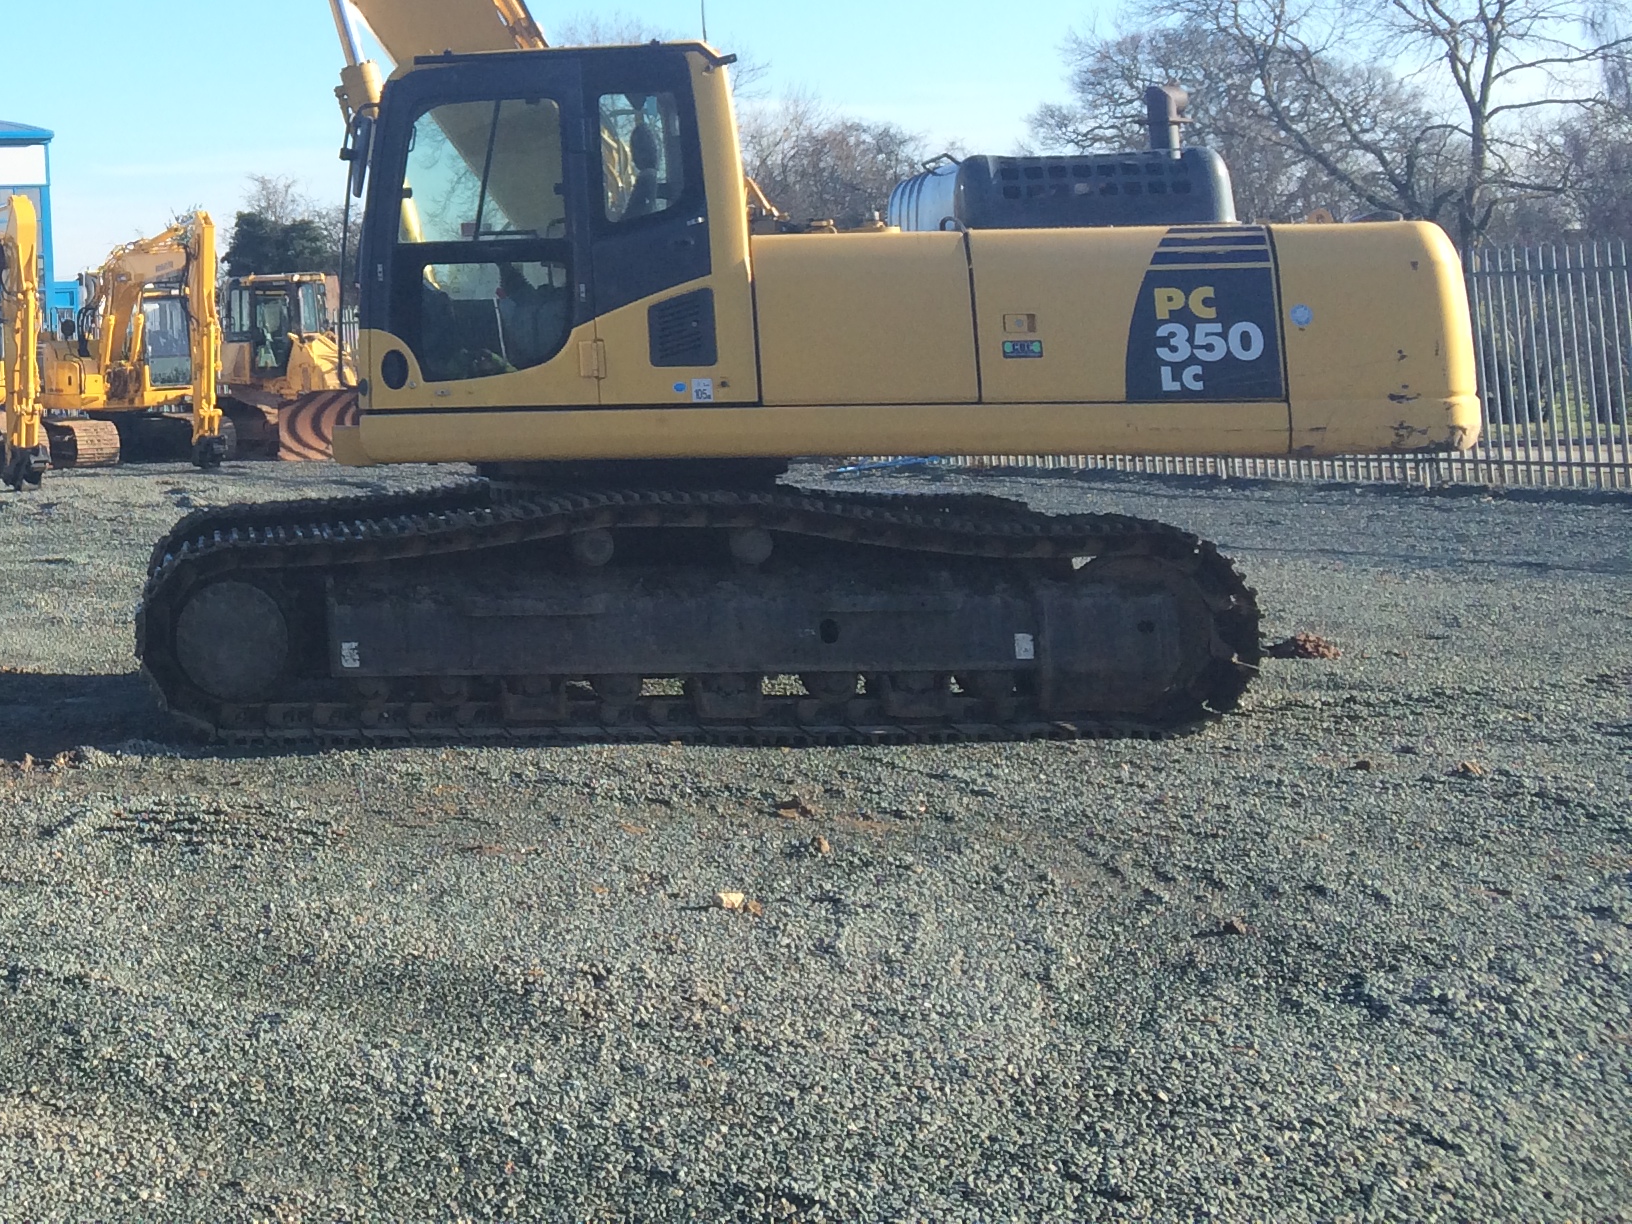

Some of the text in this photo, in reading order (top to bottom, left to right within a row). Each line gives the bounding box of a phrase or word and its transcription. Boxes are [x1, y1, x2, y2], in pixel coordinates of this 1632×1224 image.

[1154, 286, 1217, 320] PC
[1156, 321, 1264, 363] 350
[1160, 364, 1204, 391] LC
